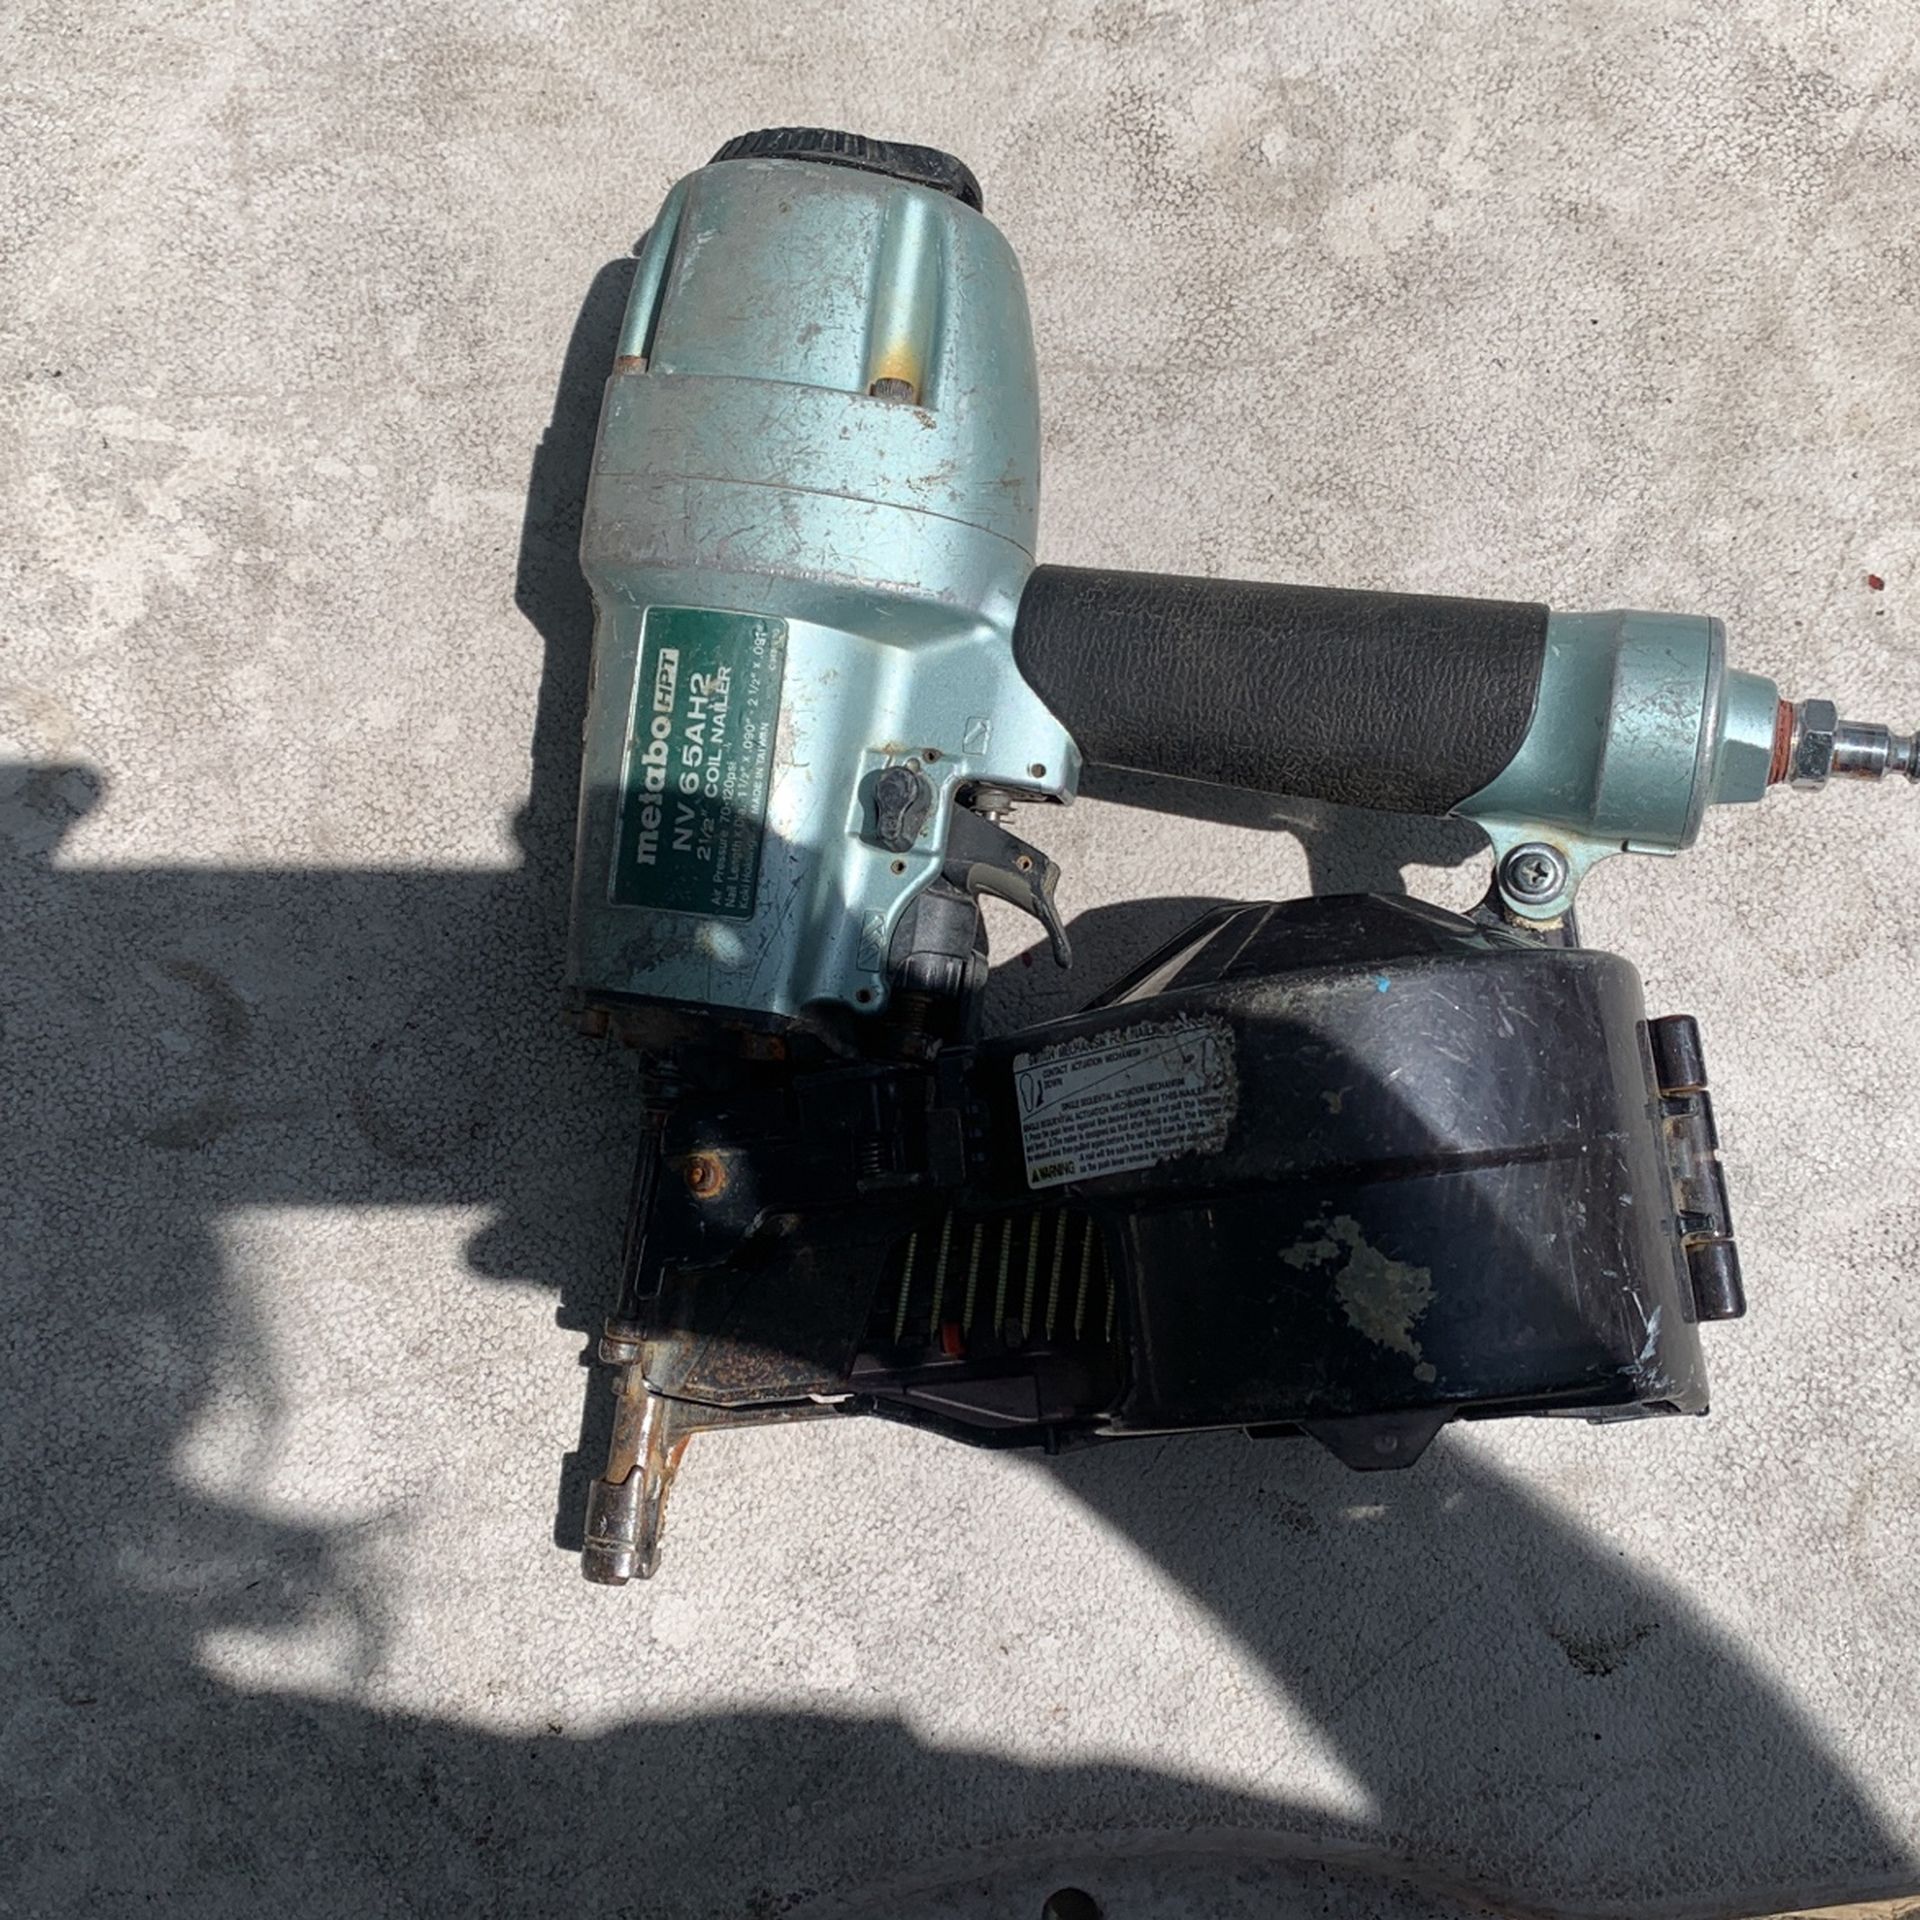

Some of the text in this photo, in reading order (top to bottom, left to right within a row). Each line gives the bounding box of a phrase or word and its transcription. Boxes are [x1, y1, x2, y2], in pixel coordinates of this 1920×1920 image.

[709, 665, 733, 744] NAILER
[636, 649, 679, 865] metabo HPT
[672, 671, 713, 852] NV 65AH2
[704, 748, 723, 798] COIL
[754, 767, 764, 779] IN
[750, 780, 763, 814] MADE
[714, 828, 729, 883] Pressure
[727, 839, 745, 880] Length
[724, 885, 737, 907] Nail
